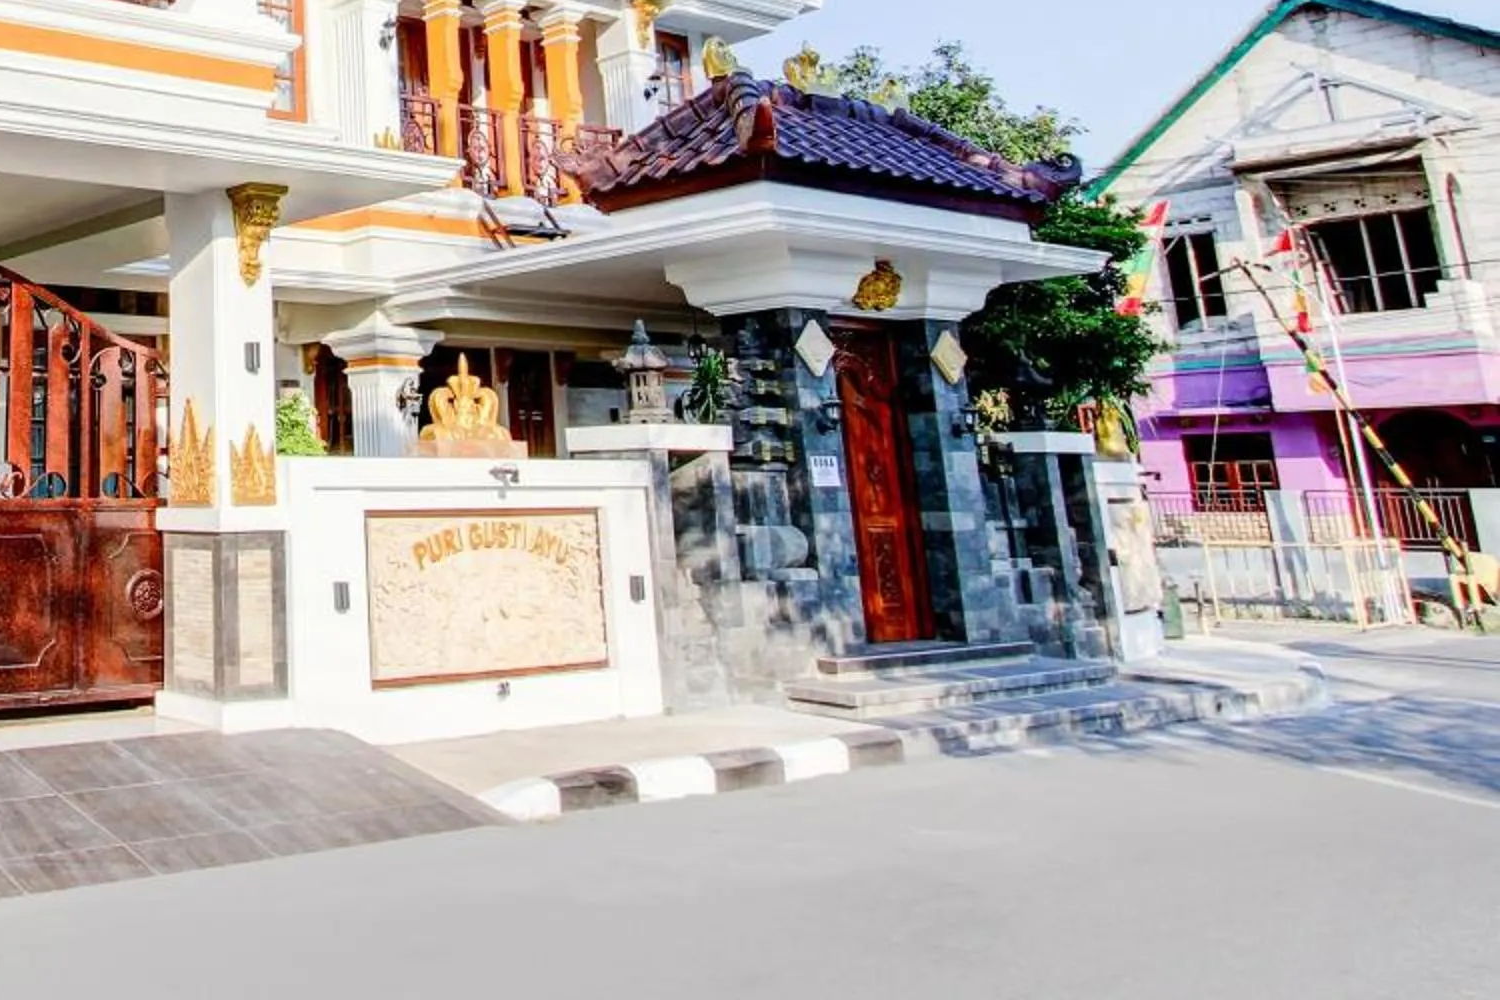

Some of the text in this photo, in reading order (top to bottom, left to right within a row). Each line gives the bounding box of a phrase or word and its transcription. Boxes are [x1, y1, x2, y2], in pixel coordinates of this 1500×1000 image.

[413, 521, 570, 571] PURI GUSTI AYU
